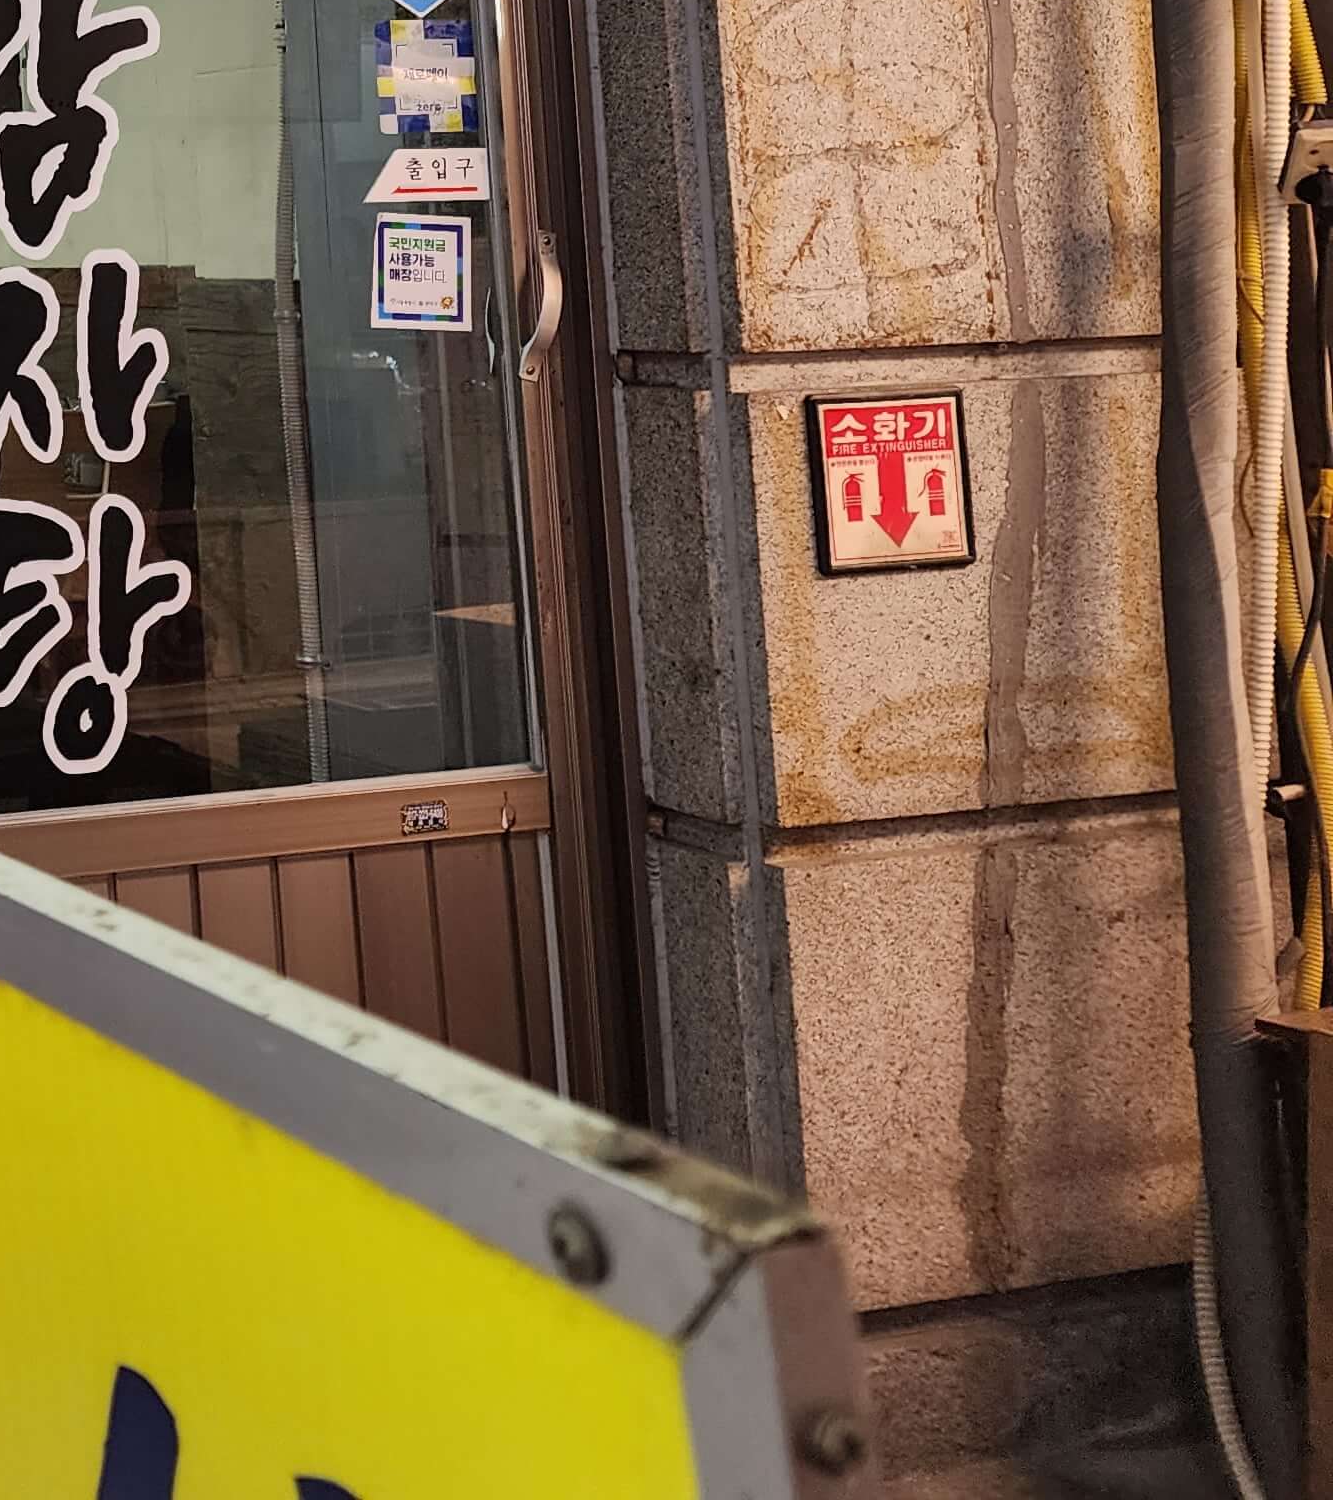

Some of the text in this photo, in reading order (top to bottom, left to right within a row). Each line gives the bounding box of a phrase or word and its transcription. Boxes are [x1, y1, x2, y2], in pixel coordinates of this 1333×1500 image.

[405, 157, 474, 181] 출입구
[388, 237, 446, 252] 국민지원금
[388, 253, 436, 268] 사용가능
[830, 408, 947, 444] 소화기
[833, 439, 947, 455] FIRE EXTINGUISHER
